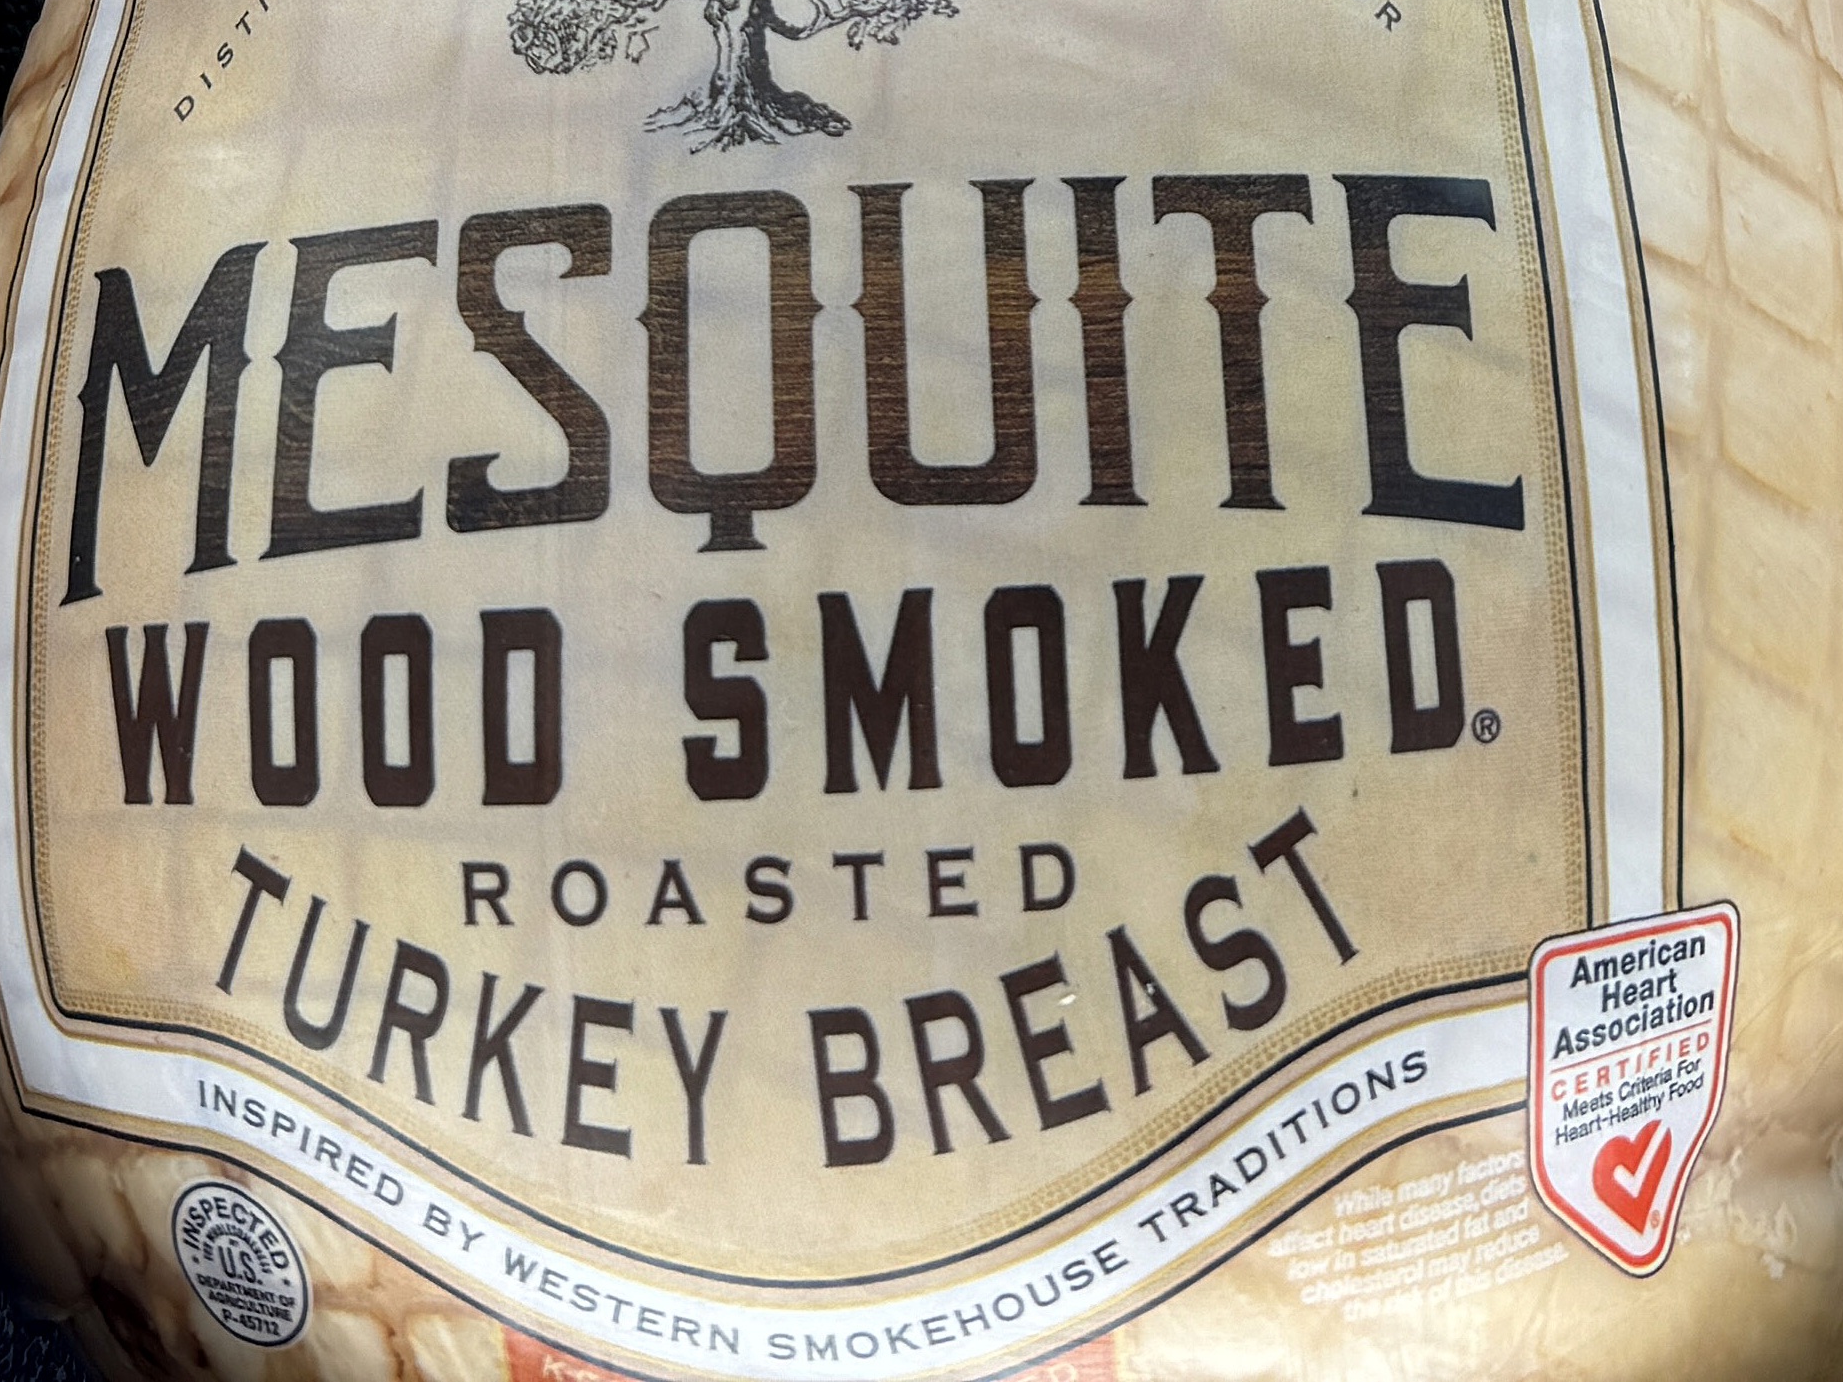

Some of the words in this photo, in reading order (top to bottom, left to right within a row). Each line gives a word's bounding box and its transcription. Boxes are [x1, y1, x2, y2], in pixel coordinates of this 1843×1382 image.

[60, 173, 1525, 607] MESQUITE
[105, 608, 563, 808] WOOD
[683, 557, 1466, 803] SMOKED
[461, 841, 1076, 928] ROASTED
[214, 842, 730, 1167] TURKEY
[807, 806, 1360, 1169] BREAST
[1570, 934, 1707, 989] American
[1600, 968, 1678, 1014] Heart
[1551, 988, 1716, 1061] Association
[1551, 1031, 1711, 1101] CERTIFIED
[1562, 1089, 1615, 1122] Meets
[1617, 1068, 1674, 1104] Criteria
[1676, 1056, 1703, 1083] For
[1555, 1096, 1665, 1147] Heart-Healthy
[1668, 1075, 1705, 1103] Food
[197, 1079, 405, 1208] INSPIRED
[422, 1203, 487, 1254] BY
[503, 1246, 742, 1355] WESTERN
[767, 1239, 1131, 1363] SMOKEHOUSE
[1139, 1049, 1431, 1245] TRADITIONS
[1334, 1186, 1394, 1218] While
[1397, 1169, 1455, 1204] many
[1338, 1214, 1395, 1245] heart
[1480, 1174, 1527, 1207] diets
[183, 1195, 291, 1270] INSPECTED
[218, 1245, 264, 1286] U.S.
[1299, 1259, 1425, 1305] cholesterol
[1426, 1248, 1472, 1280] may
[1474, 1224, 1540, 1260] reduce
[1334, 1250, 1356, 1272] in
[1359, 1224, 1459, 1267] saturated
[1463, 1214, 1490, 1239] fat
[1493, 1197, 1530, 1229] and
[196, 1273, 276, 1304] DEPARTMENT
[208, 1289, 294, 1323] AGRICULTURE
